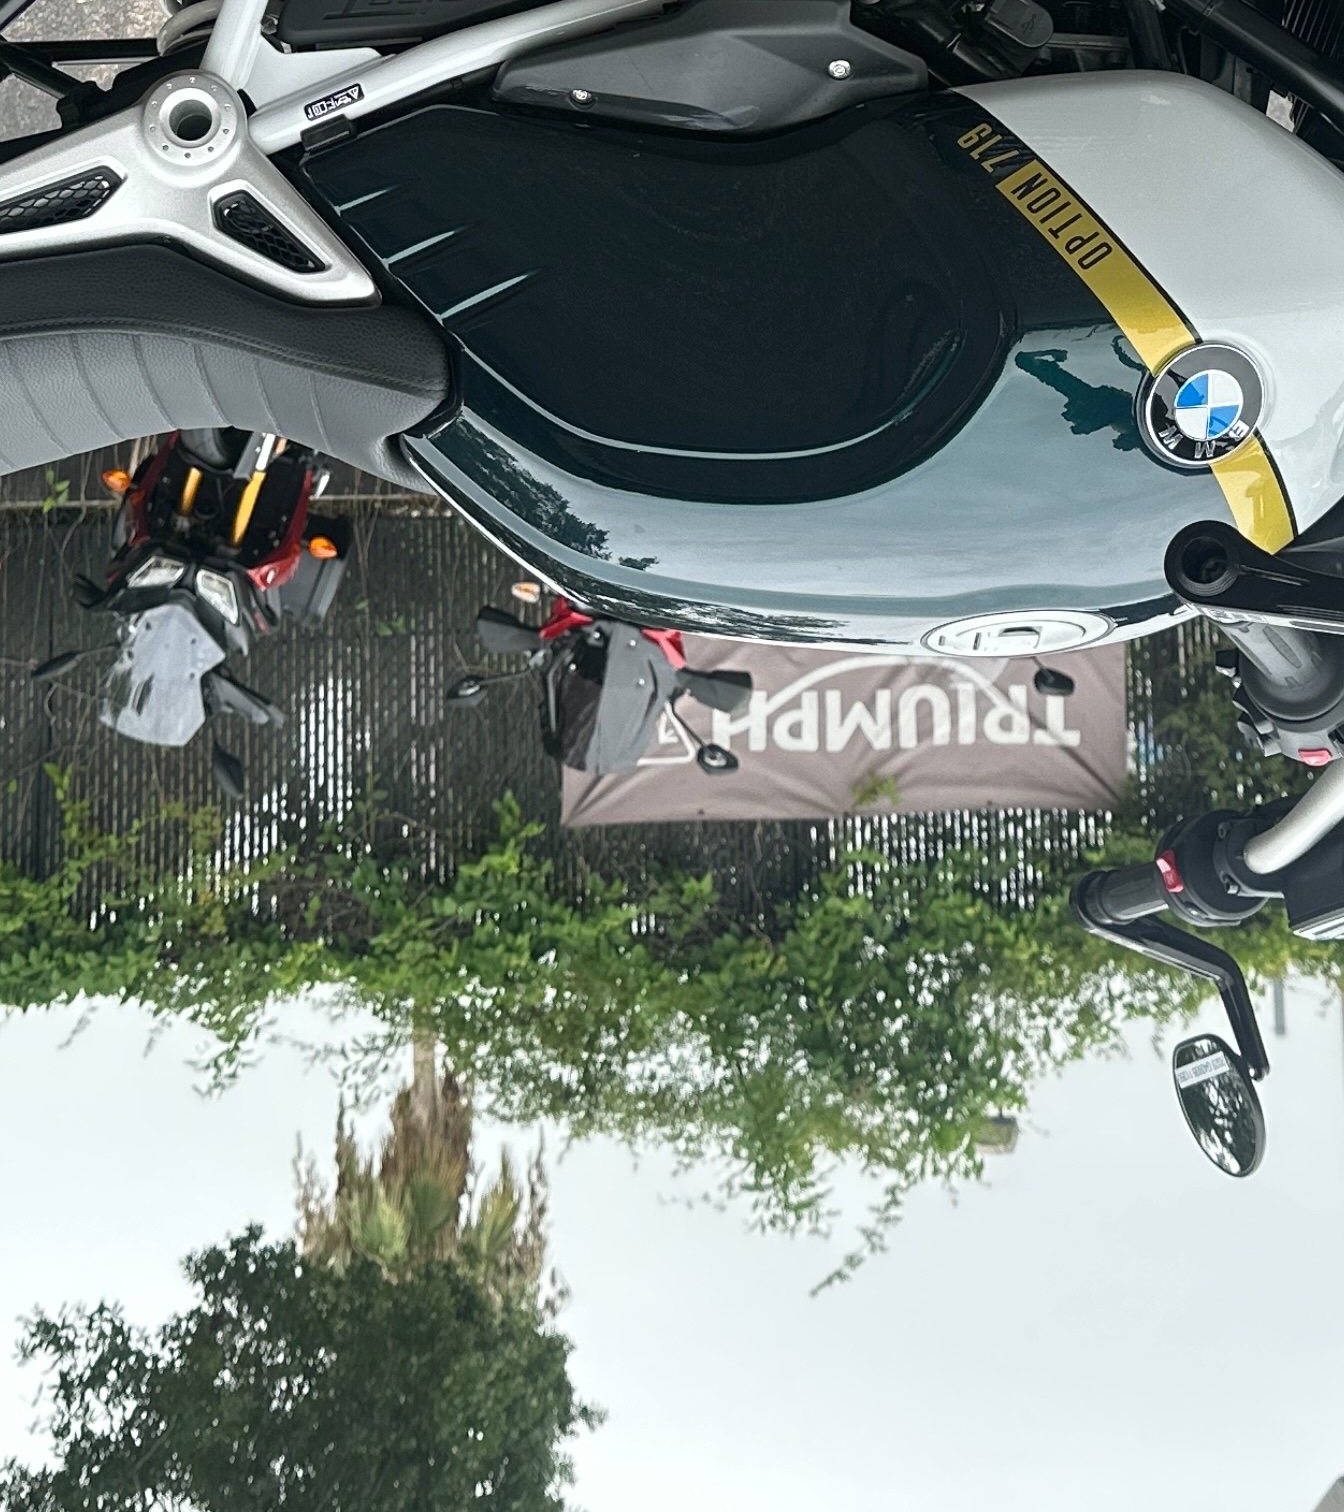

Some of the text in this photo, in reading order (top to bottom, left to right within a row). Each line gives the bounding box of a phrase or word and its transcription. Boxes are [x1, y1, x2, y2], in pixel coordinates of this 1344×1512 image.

[956, 121, 1113, 270] OPTION 719
[1157, 421, 1250, 461] BMW
[712, 680, 1081, 753] TRIUMPH
